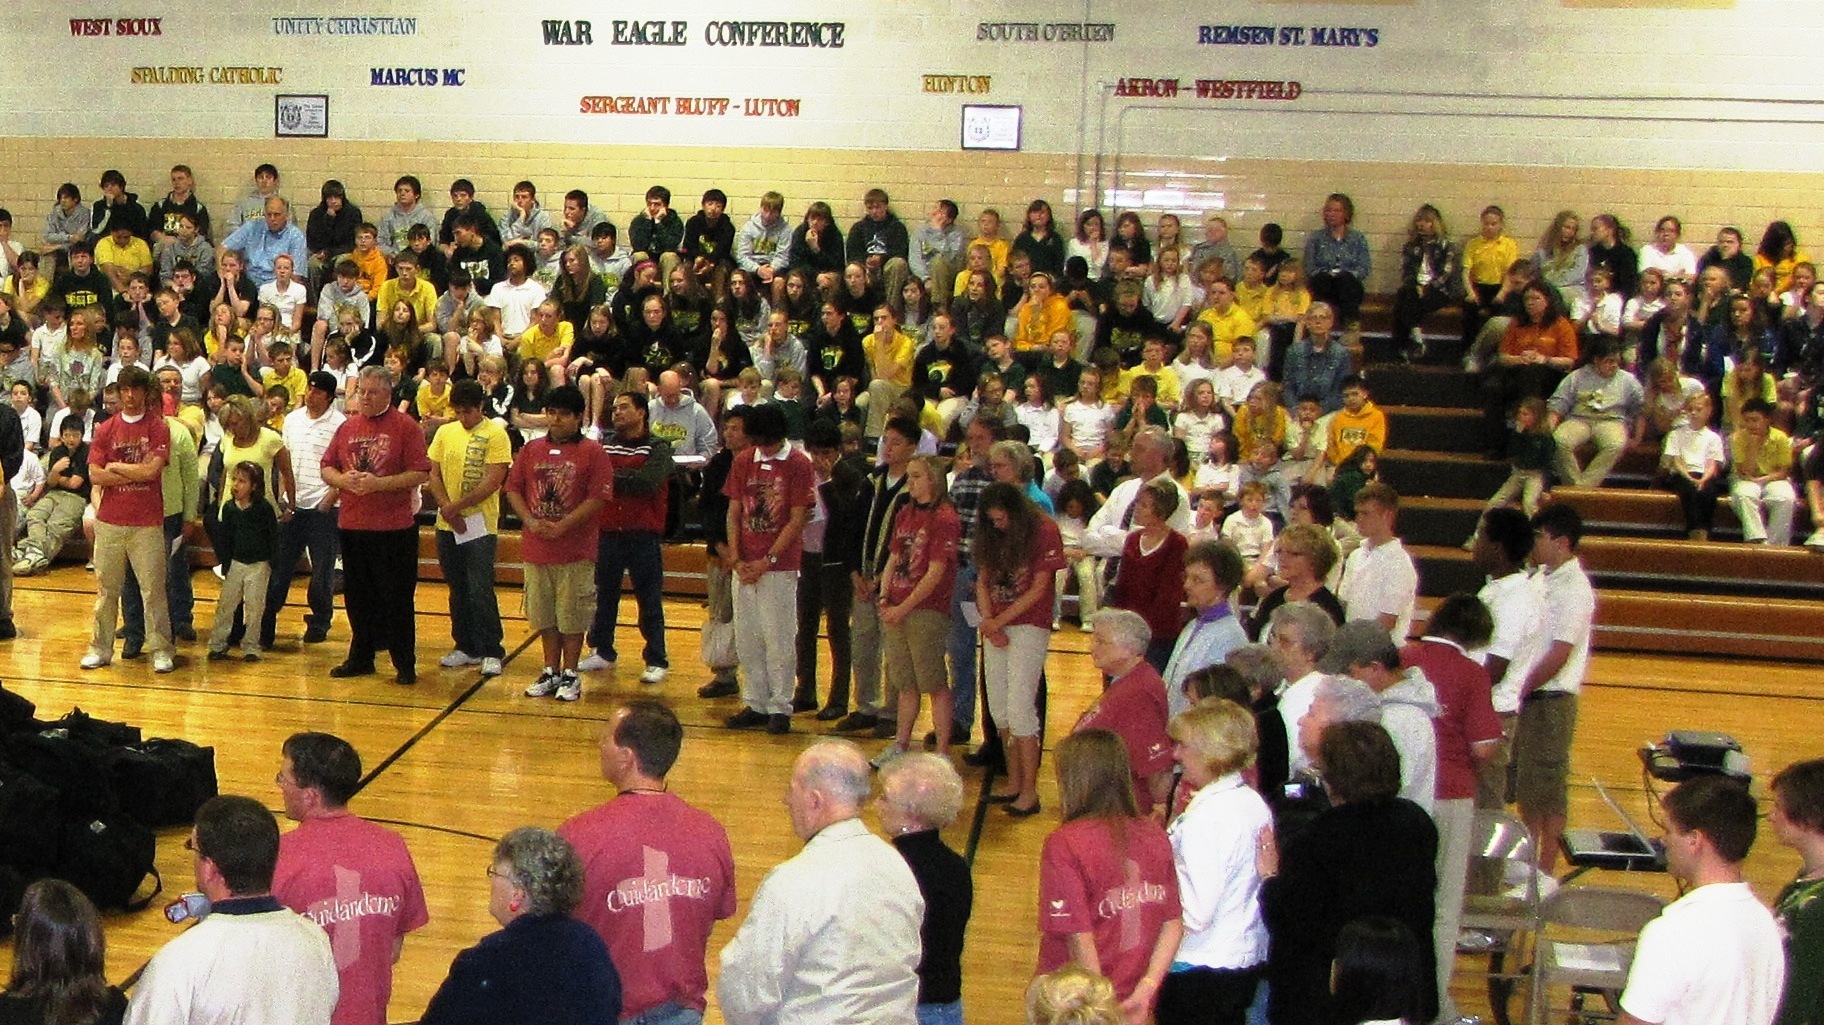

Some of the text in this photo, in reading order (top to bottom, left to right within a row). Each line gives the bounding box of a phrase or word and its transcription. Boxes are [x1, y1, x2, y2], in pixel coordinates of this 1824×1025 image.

[69, 18, 164, 36] WEST SIOUX
[272, 18, 417, 35] UNITY CHRISTIAN
[542, 20, 845, 48] WAR EAGLE CONFERENCE
[976, 23, 1039, 41] SOUTH
[1198, 25, 1379, 47] REMSEN ST. MARY'S
[131, 67, 283, 85] SPALDING CATHOLIC
[370, 68, 465, 86] MARCUS MC
[921, 74, 992, 94] HINTON
[1195, 79, 1302, 100] WESTFIELD
[580, 96, 670, 115] SERGEANT
[675, 97, 730, 115] BLUFF
[744, 98, 801, 117] LUTON
